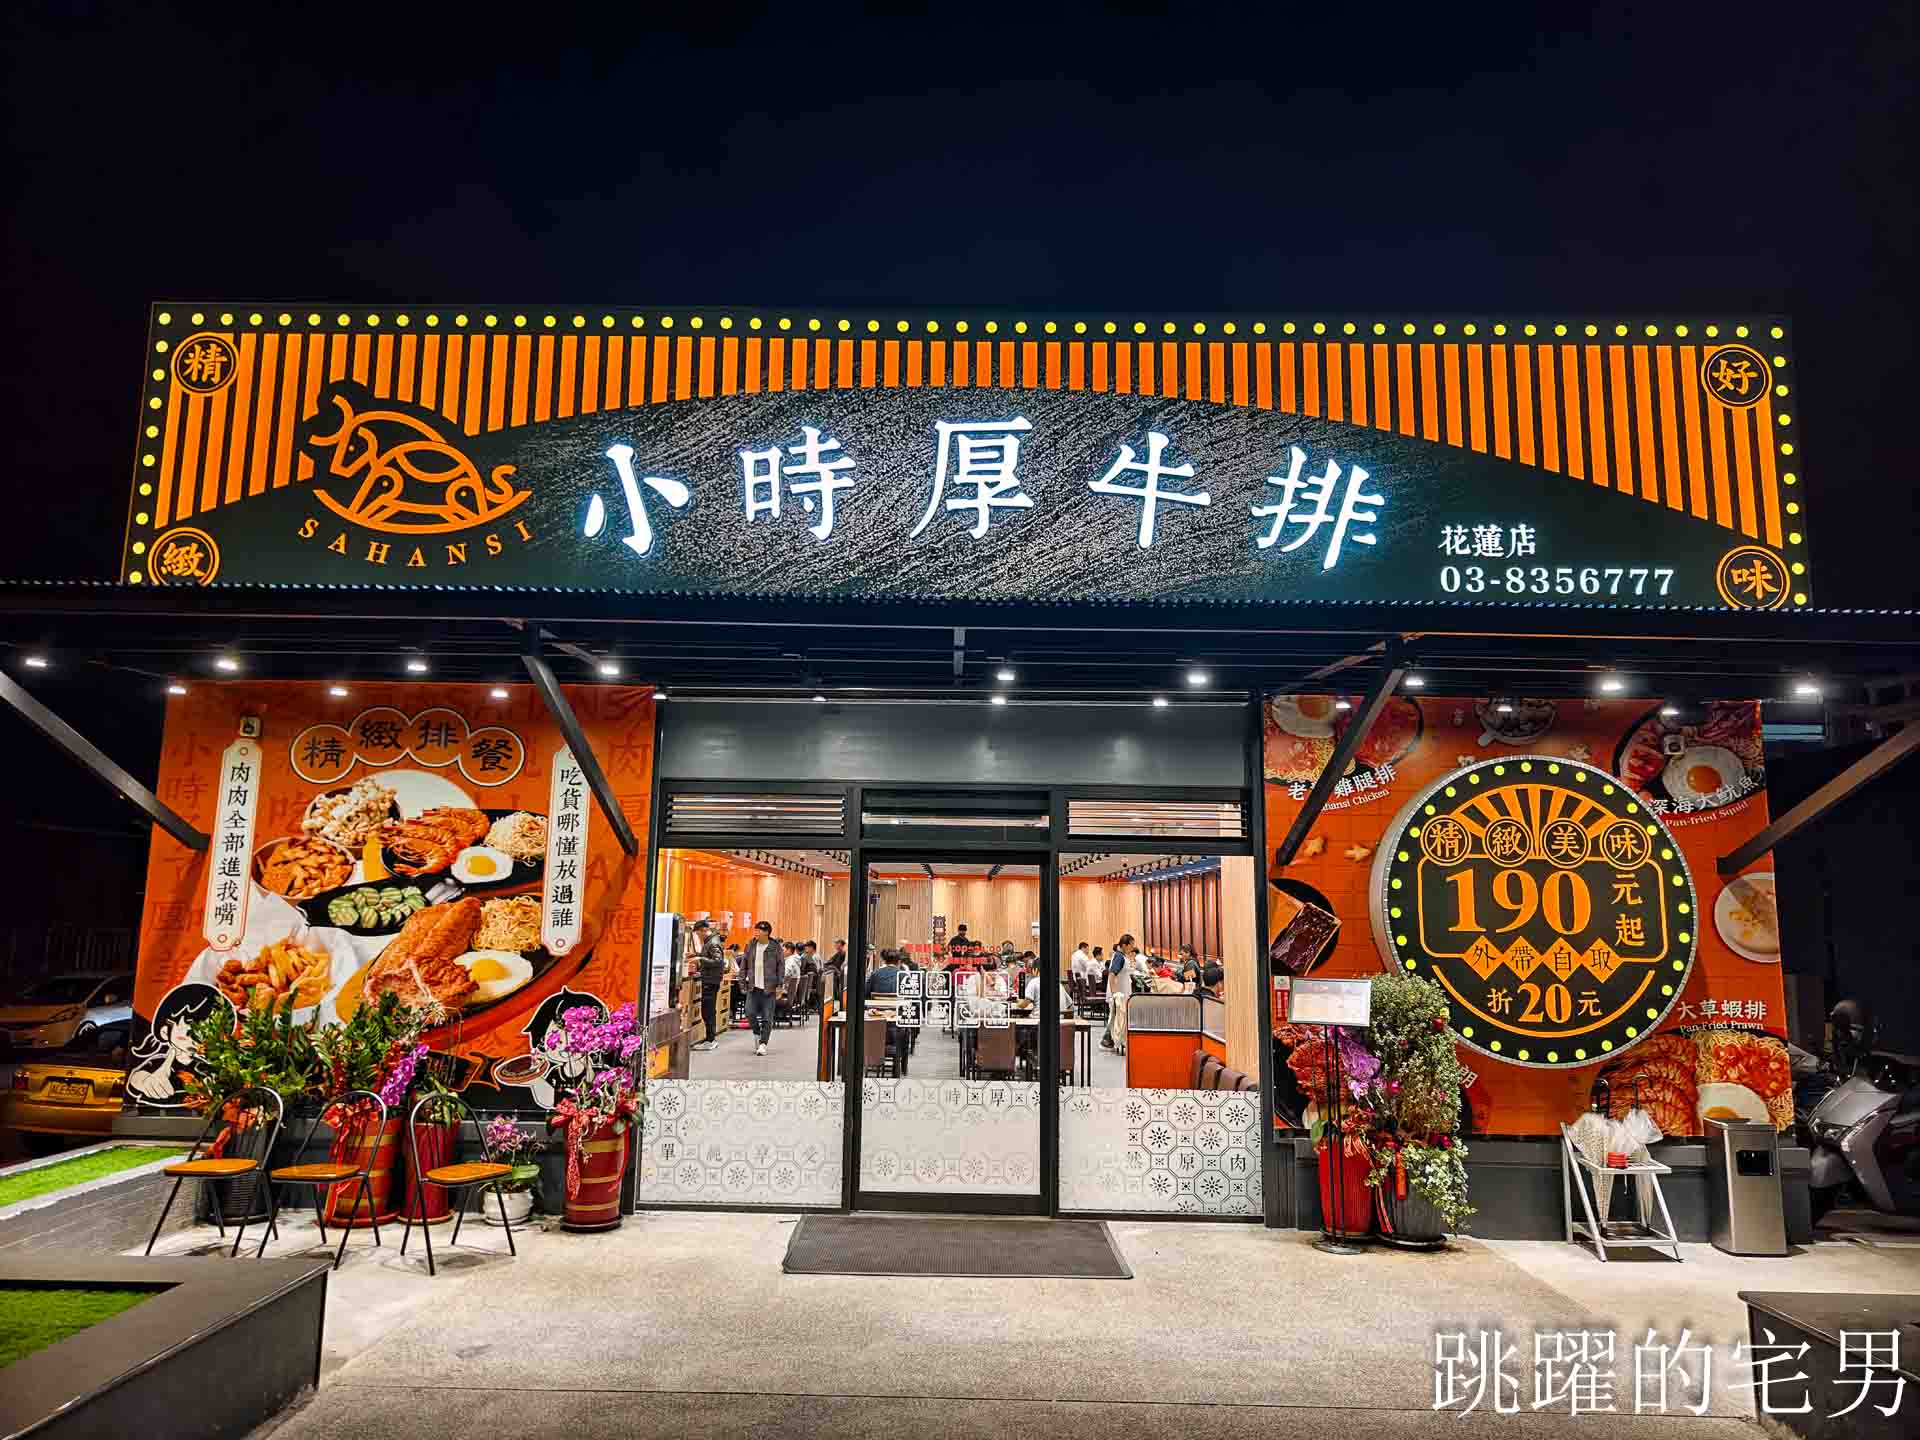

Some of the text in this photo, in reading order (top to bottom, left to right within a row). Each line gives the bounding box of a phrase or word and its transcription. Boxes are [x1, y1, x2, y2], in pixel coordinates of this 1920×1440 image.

[183, 344, 228, 383] 精
[1712, 360, 1758, 394] 好
[583, 416, 1386, 573] 小時厚牛排
[161, 542, 207, 579] 緻
[298, 518, 534, 567] SAHANSI
[1438, 525, 1537, 558] 花蓮店
[1440, 566, 1674, 595] 03-8356777
[1731, 559, 1779, 599] 味
[301, 720, 513, 771] 精緻排餐
[1288, 762, 1397, 800] 老雞腿排
[1352, 788, 1390, 806] Chicken
[215, 761, 251, 926] 肉肉全部進我嘴
[551, 766, 583, 929] 吃貨哪懂放過誰
[1429, 823, 1643, 860] 精緻美味
[1446, 867, 1592, 935] 190
[1611, 873, 1645, 947] 元起
[1472, 942, 1614, 972] 外帶自取
[1677, 999, 1767, 1020] 大草蝦排
[1731, 1021, 1764, 1030] Prawn
